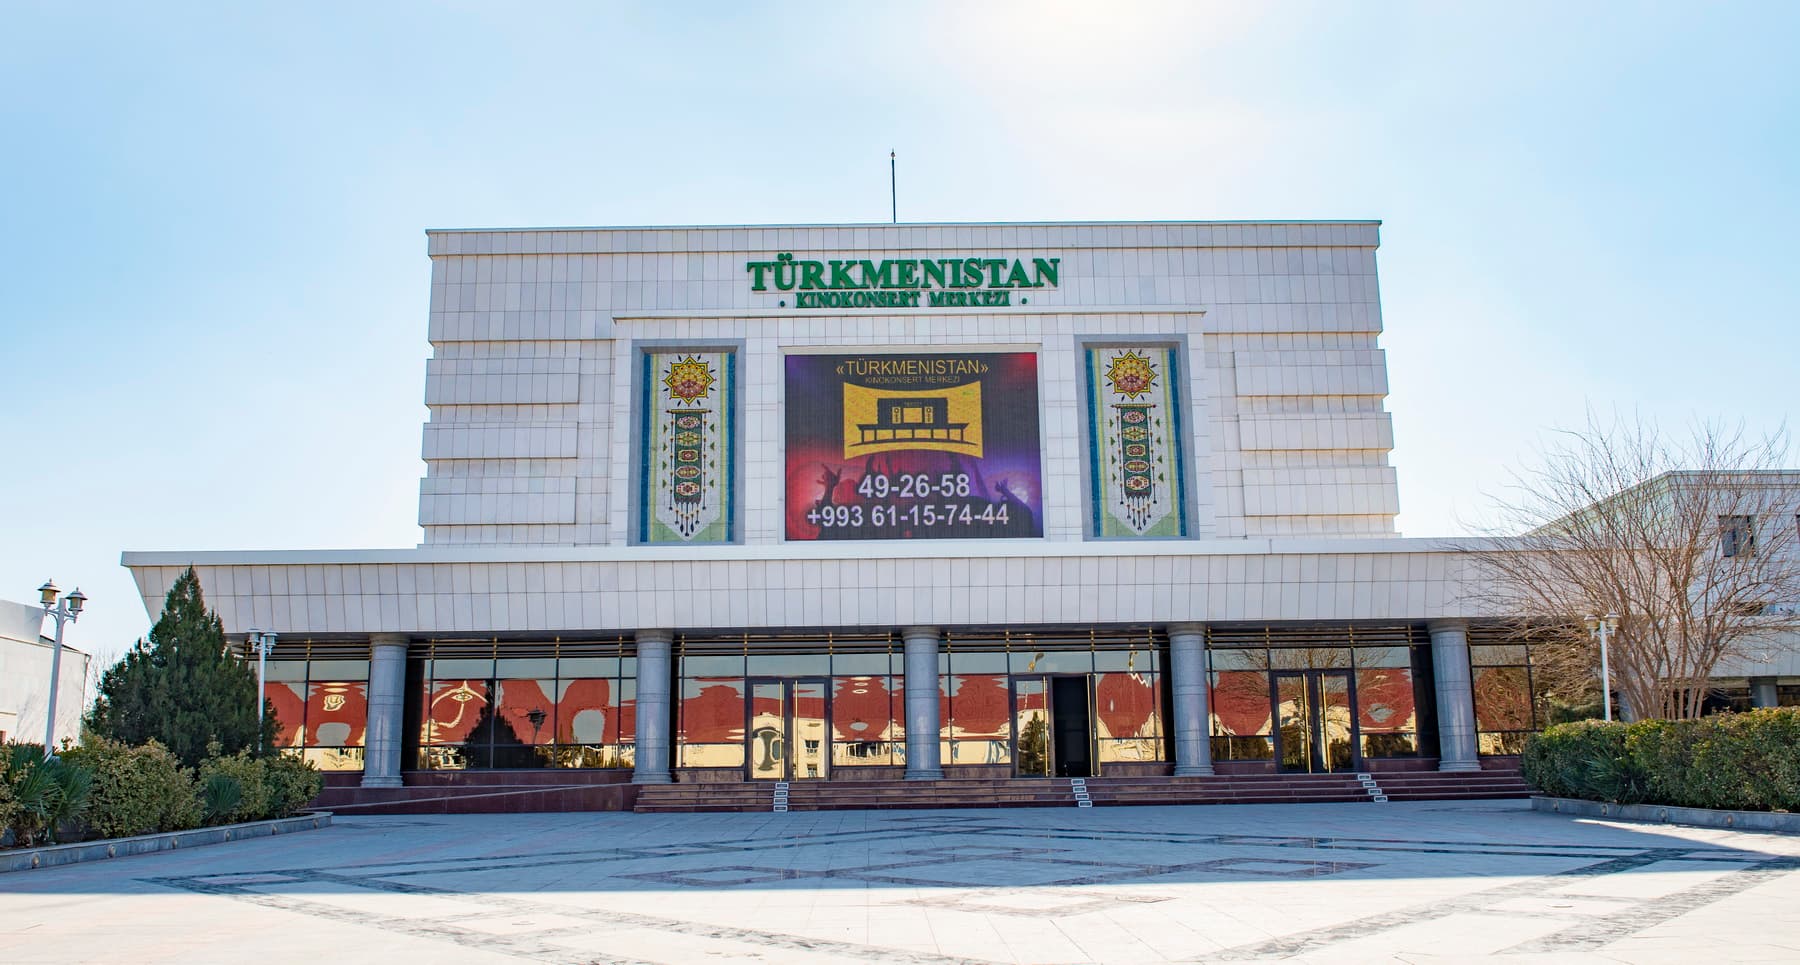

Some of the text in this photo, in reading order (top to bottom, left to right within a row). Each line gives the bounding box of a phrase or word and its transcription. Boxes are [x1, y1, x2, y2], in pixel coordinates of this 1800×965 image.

[747, 253, 1060, 291] TÜRKMENISTAN
[796, 290, 1011, 308] KINOKONSERT MERKEZI
[836, 358, 989, 375] «TÜRKMENISTAN»
[865, 375, 960, 384] KINOKONSERT MERKEZI
[858, 474, 970, 498] 49-26-58
[807, 504, 1009, 527] +993 61-15-74-44
